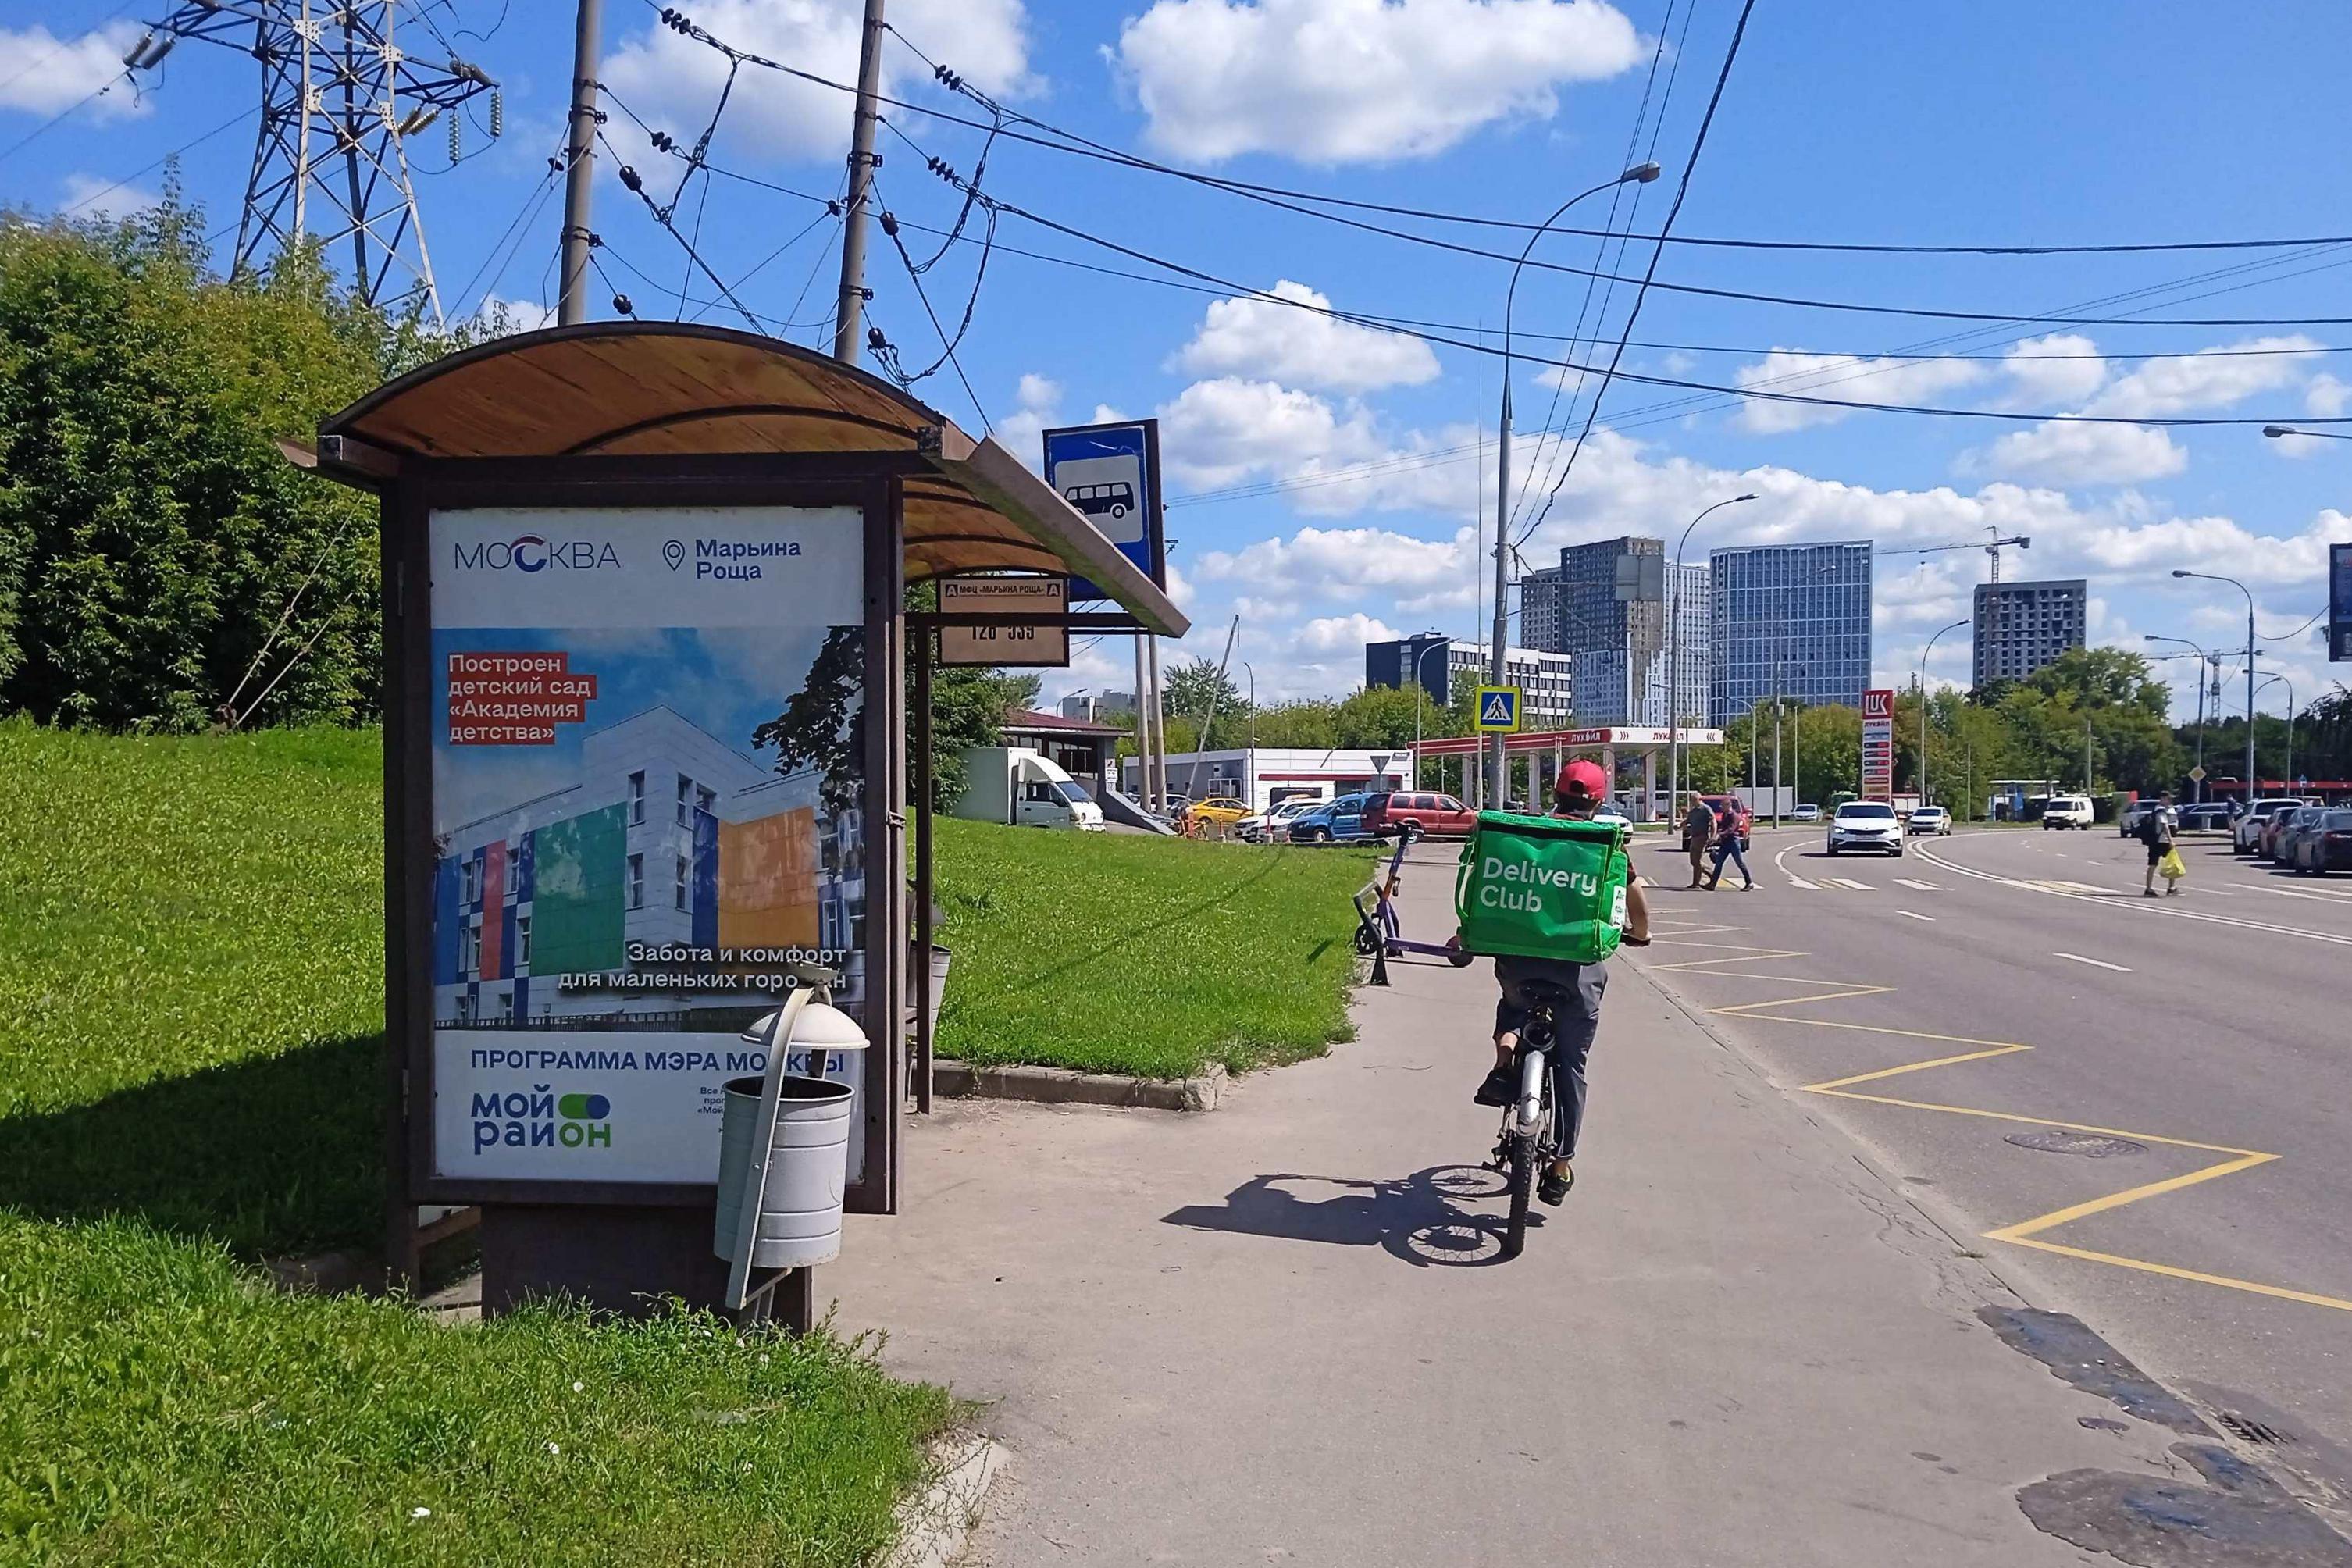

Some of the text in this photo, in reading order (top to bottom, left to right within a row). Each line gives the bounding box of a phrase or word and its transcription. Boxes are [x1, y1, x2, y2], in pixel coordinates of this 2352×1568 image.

[454, 533, 621, 572] МОСКВА
[696, 539, 801, 560] Марьина
[696, 561, 762, 582] Роща
[449, 655, 561, 675] Построен
[448, 677, 590, 698] детский сад
[449, 701, 579, 720] «Академия
[449, 725, 554, 743] детства»
[1482, 857, 1598, 897] Delivery
[1480, 885, 1543, 913] Club
[628, 943, 846, 967] Забота и комфорт
[558, 973, 846, 992] для маленьких горон
[471, 1049, 637, 1071] ПРОГРАММА
[645, 1052, 720, 1071] МЭРА
[471, 1084, 554, 1118] мой
